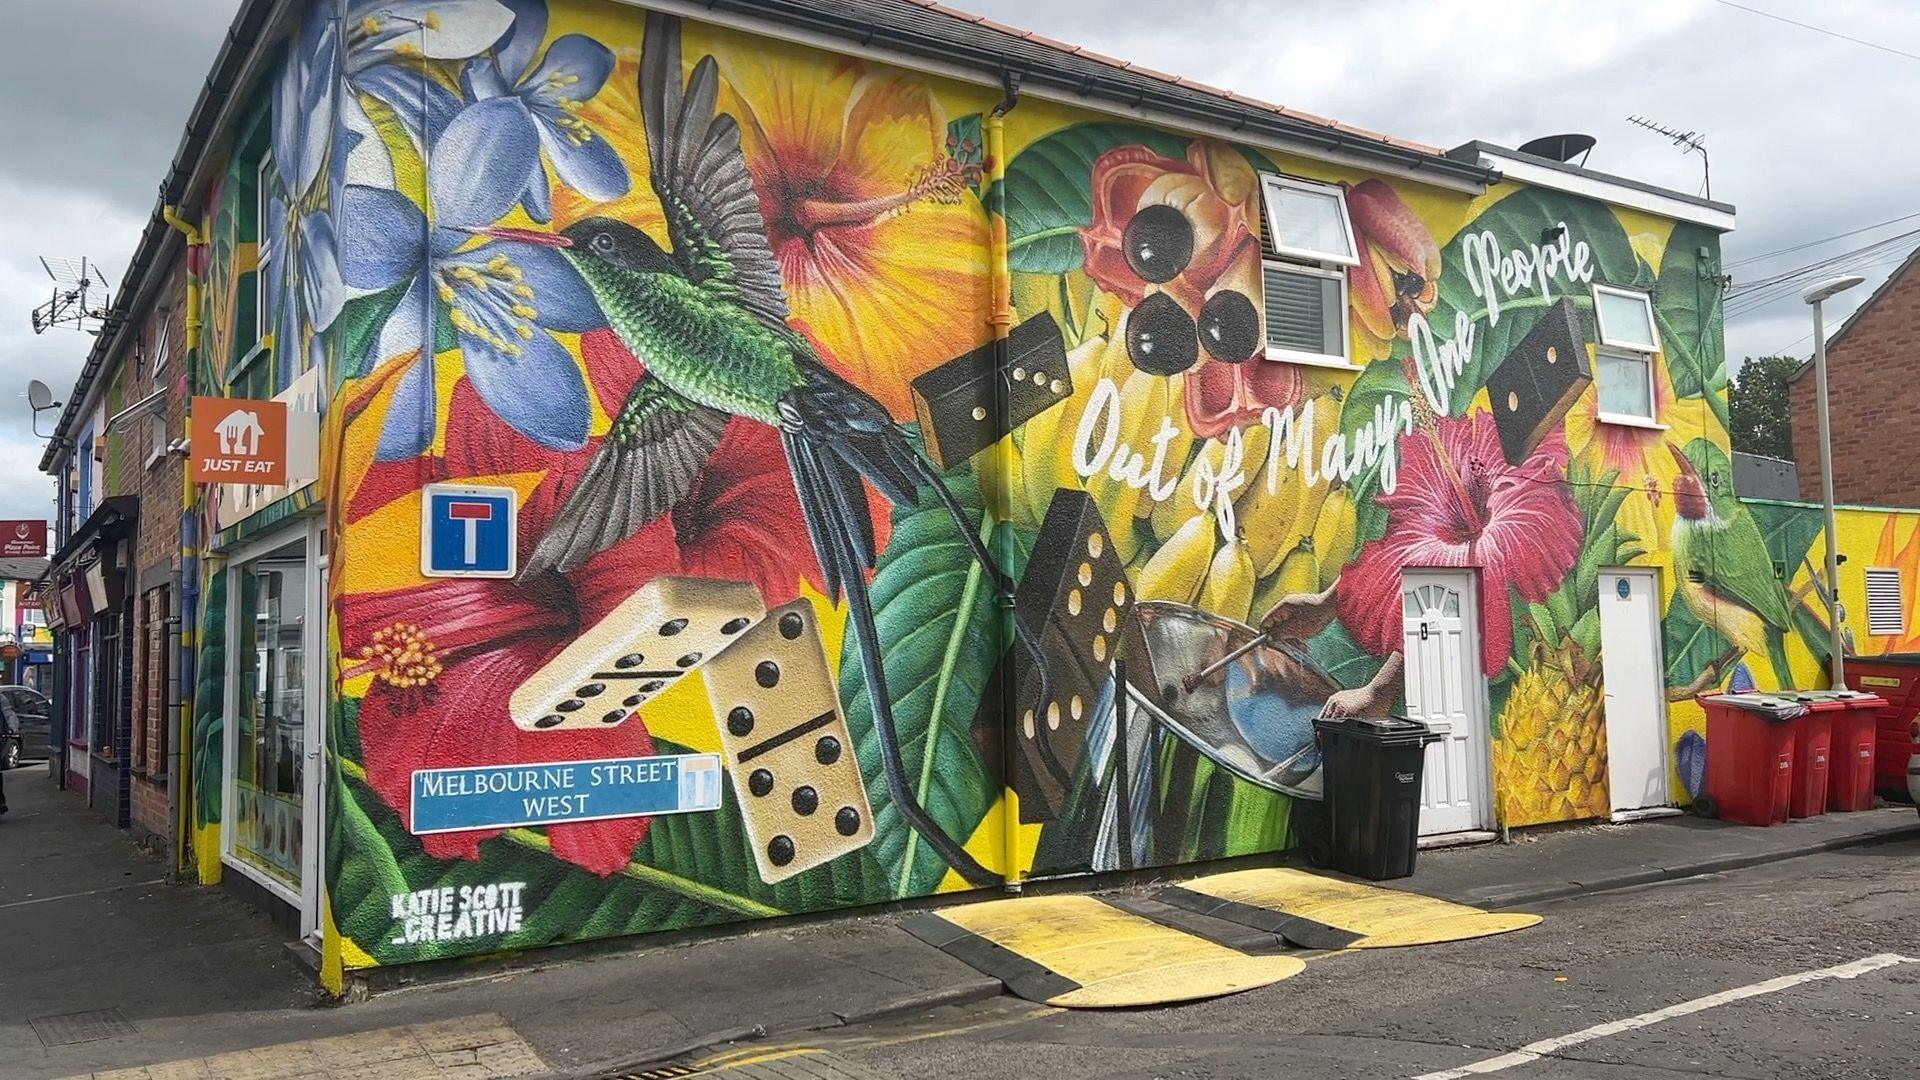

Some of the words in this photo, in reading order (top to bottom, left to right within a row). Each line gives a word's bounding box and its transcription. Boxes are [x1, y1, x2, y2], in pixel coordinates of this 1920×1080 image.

[1072, 378, 1181, 502] Out
[1194, 424, 1246, 542] of
[1408, 310, 1477, 417] One
[1462, 222, 1594, 328] People
[201, 458, 241, 473] JUST
[244, 460, 275, 474] EAT
[421, 768, 575, 797] MELBOURNE
[590, 761, 677, 786] STREET
[523, 794, 590, 818] WEST
[392, 886, 453, 919] KATIE
[459, 881, 527, 910] SCOTT
